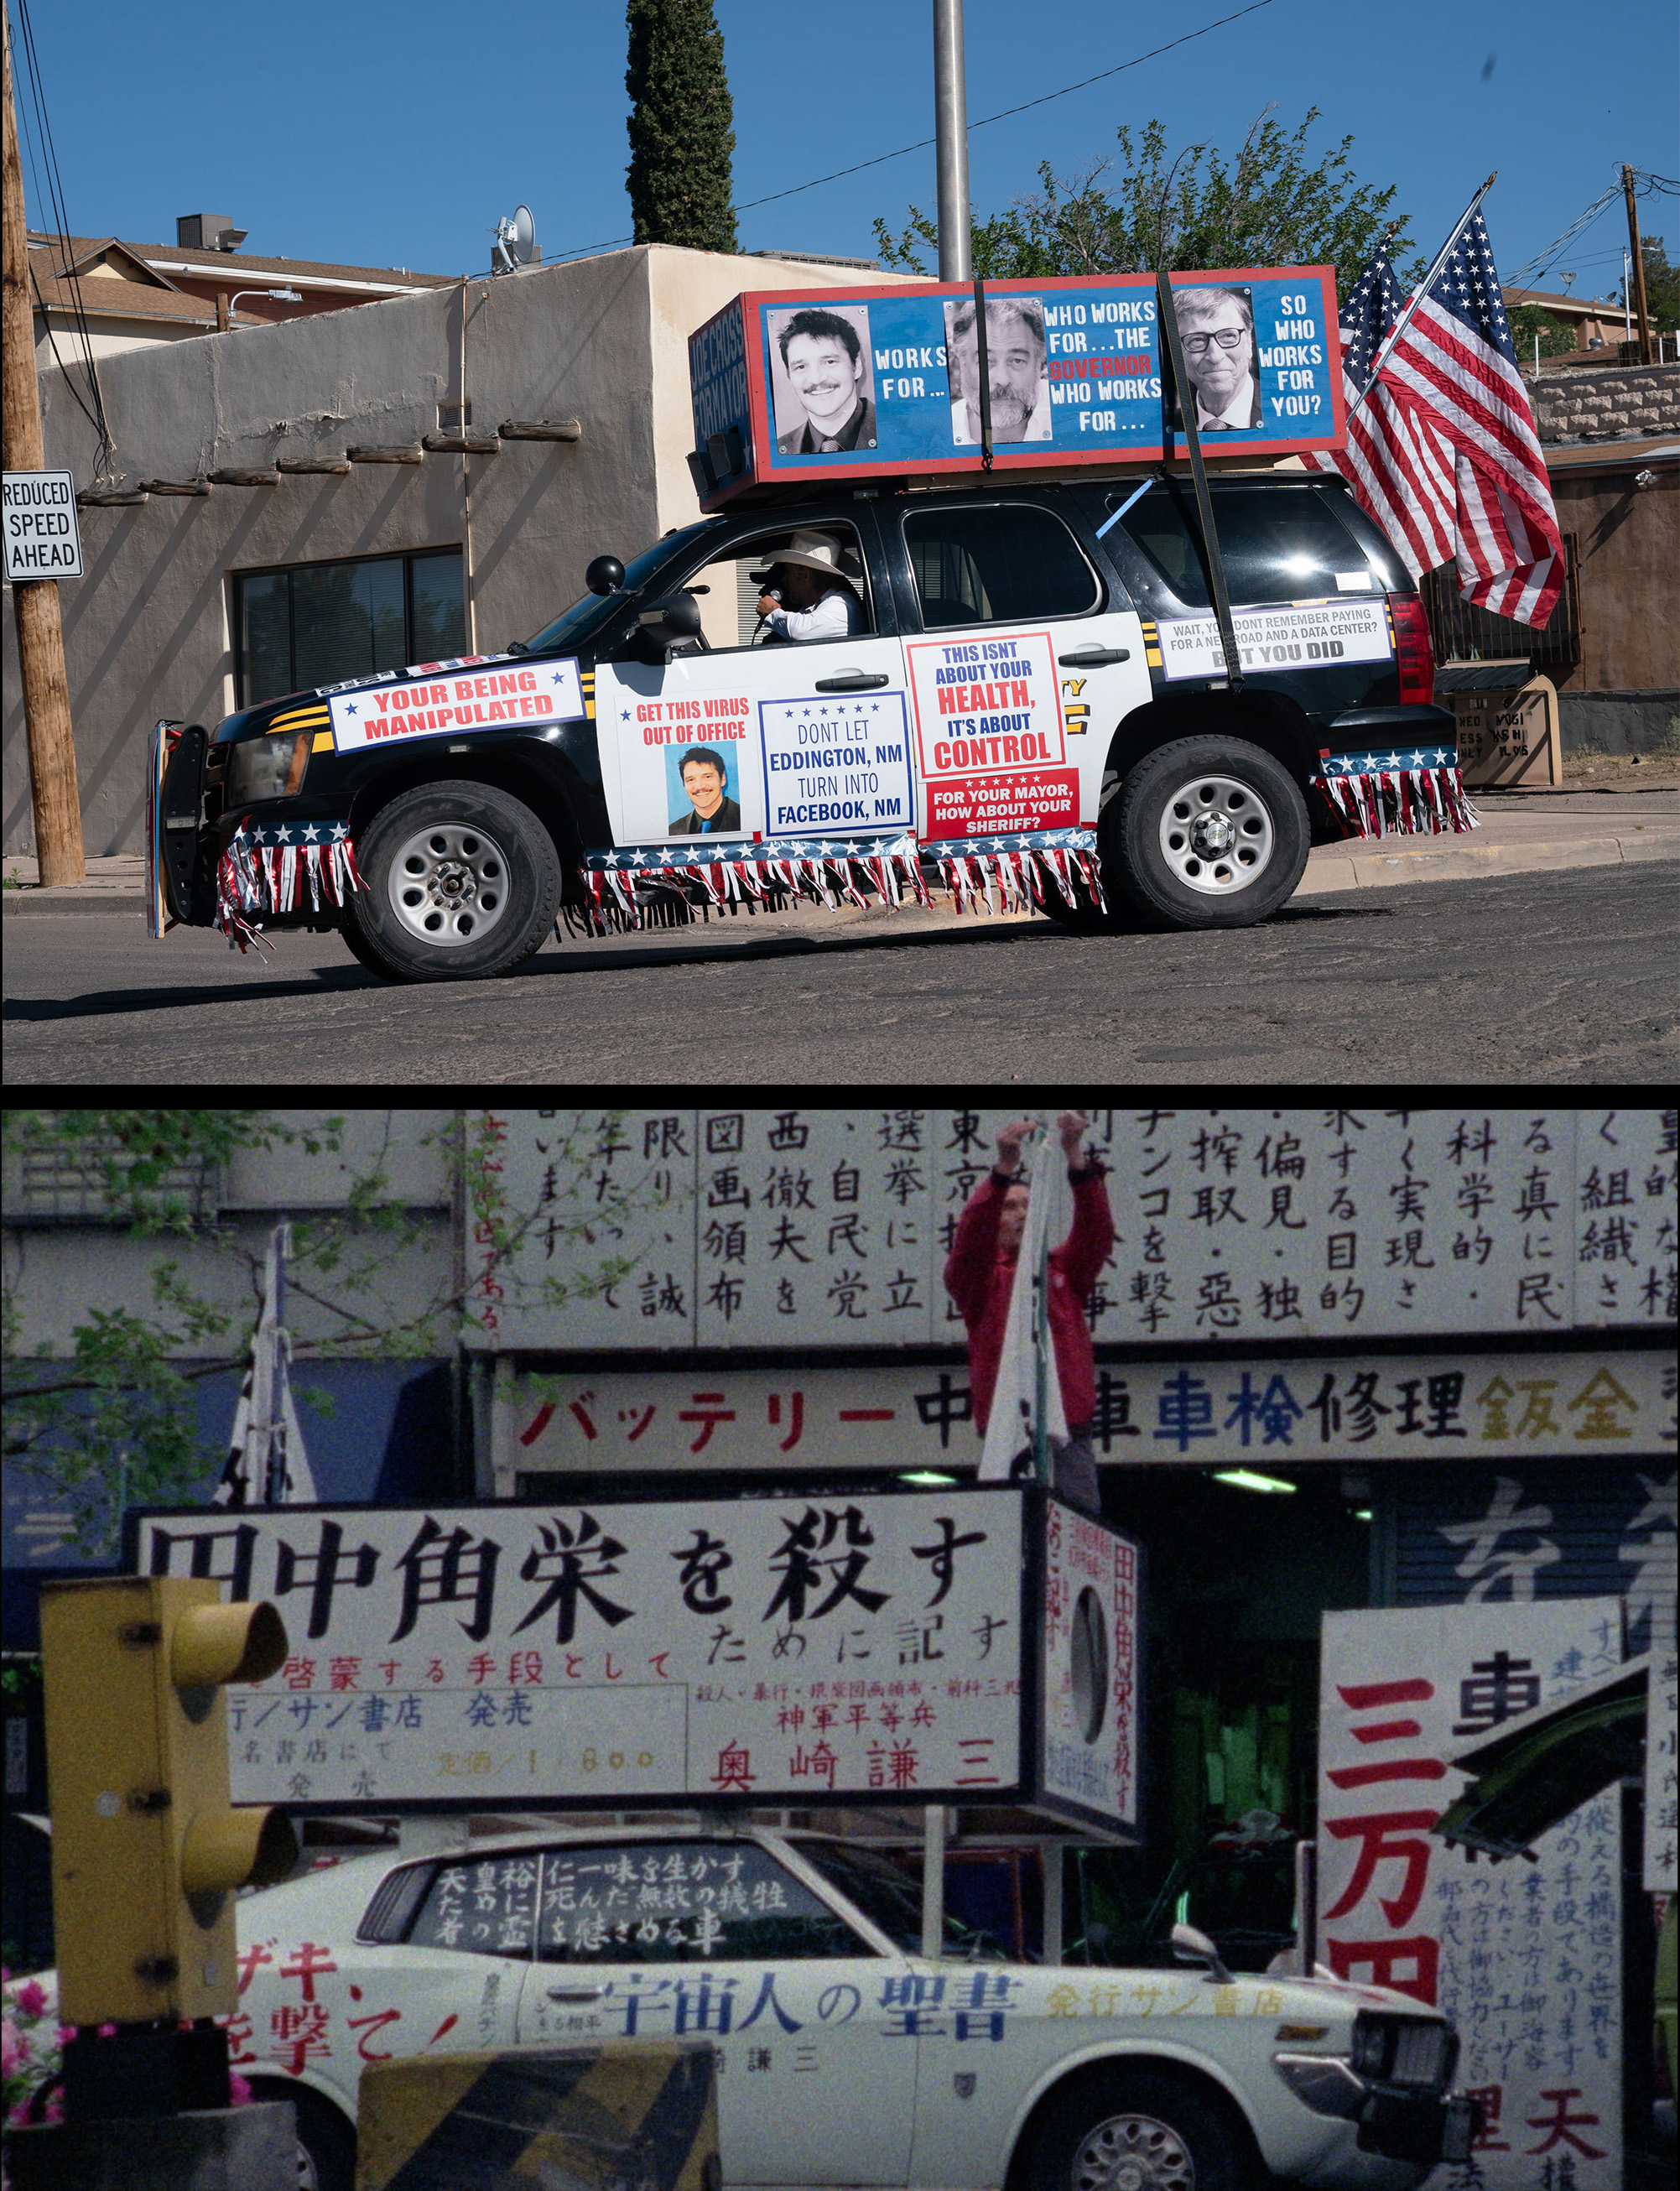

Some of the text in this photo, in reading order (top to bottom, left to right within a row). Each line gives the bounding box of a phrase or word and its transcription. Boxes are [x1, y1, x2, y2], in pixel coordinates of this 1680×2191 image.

[1043, 301, 1156, 326] WHO WORKS
[1281, 295, 1307, 315] SO
[1275, 319, 1315, 341] WHO
[692, 303, 744, 387] JOE CROSS
[875, 346, 948, 370] WORKS
[1259, 345, 1323, 367] WORKS
[1049, 354, 1152, 381] GOVERNOR
[1277, 369, 1314, 391] FOR
[693, 361, 748, 440] FOR MAYOR
[1051, 377, 1162, 404] WHO WORKS
[1272, 395, 1321, 417] YOU?
[3, 482, 70, 506] REDUCED
[10, 513, 70, 537] SPEED
[13, 544, 75, 568] AHEAD
[1171, 638, 1193, 650] FOR
[1195, 638, 1204, 648] A
[1235, 632, 1262, 644] ROAD
[1266, 629, 1288, 641] AND
[1290, 628, 1298, 638] A
[1300, 626, 1328, 638] DATA
[1329, 622, 1378, 635] CENTER?
[1173, 623, 1204, 637] WAIT,
[1235, 618, 1263, 631] DONT
[1266, 612, 1329, 629] REMEMBER
[1333, 609, 1371, 622] PAYING
[941, 641, 1017, 664] THIS ISNT
[1212, 640, 1345, 668] BT YOU DID
[935, 660, 1032, 684] ABOUT YOUR
[373, 671, 537, 712] YOUR BEING
[937, 679, 1036, 715] HEALTH,
[364, 695, 554, 740] MANIPULATED
[636, 697, 750, 722] GET THIS VIRUS
[643, 721, 746, 746] OUT OF OFFICE
[798, 719, 870, 745] DONT LET
[947, 713, 1031, 737] IT'S ABOUT
[770, 745, 902, 772] EDDINGTON, NM
[934, 731, 1051, 769] CONTROL
[798, 773, 879, 799] TURN INTO
[934, 783, 1074, 805] FOR YOUR MAYOR,
[778, 798, 902, 825] FACEBOOK, NM
[936, 799, 1071, 820] HOW ABOUT YOUR
[966, 816, 1041, 835] SHERIFF?
[709, 1614, 1006, 1665] ために記す
[465, 1690, 533, 1728] 発売
[777, 1698, 937, 1734] 神軍平等兵
[710, 1738, 999, 1791] 奥崎謙三
[604, 1971, 1024, 2043] 宇宙人の聖書
